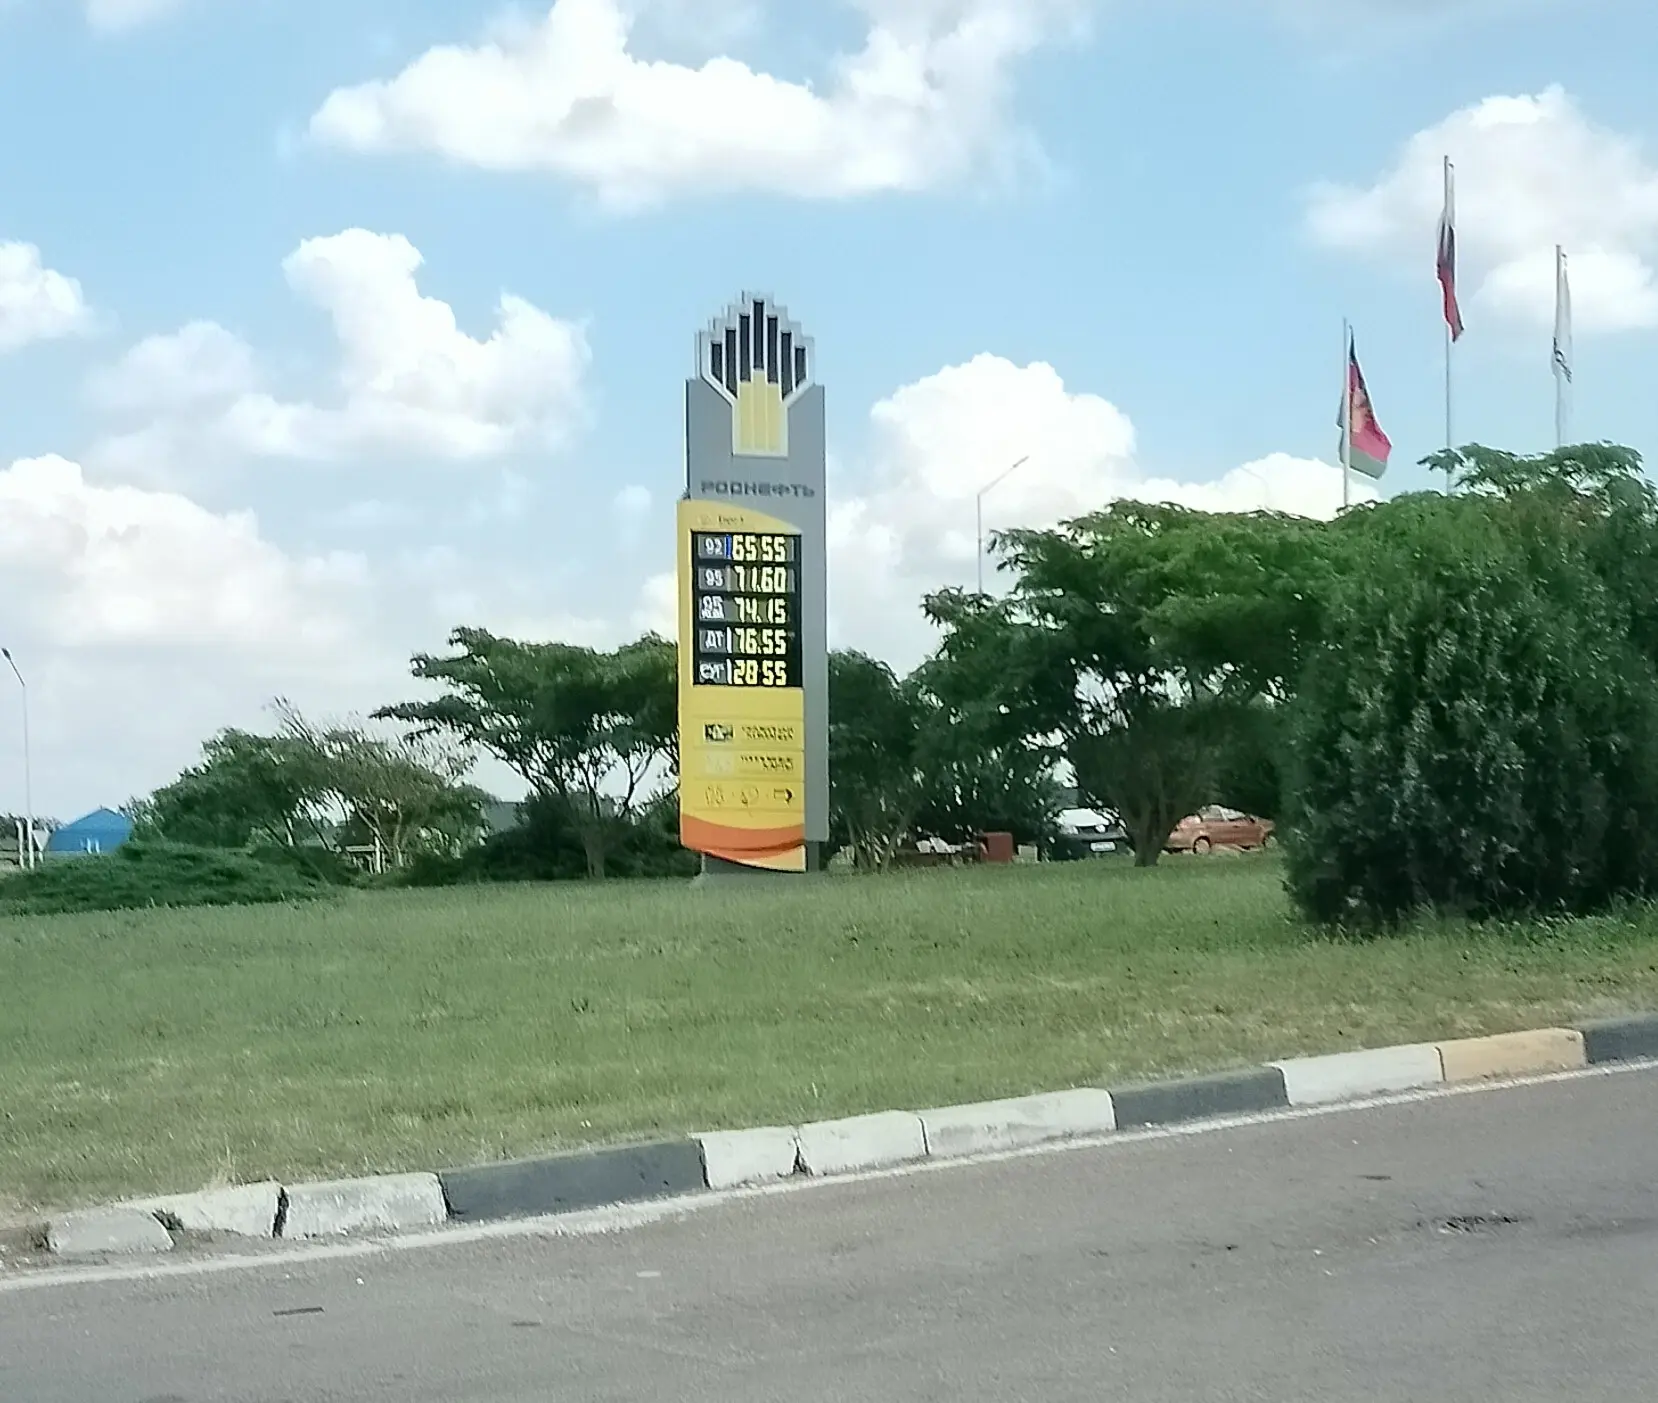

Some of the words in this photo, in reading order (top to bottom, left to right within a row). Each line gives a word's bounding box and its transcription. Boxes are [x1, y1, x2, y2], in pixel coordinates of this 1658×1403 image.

[732, 534, 786, 562] 6555
[734, 565, 787, 593] 71.60
[734, 597, 786, 624] 74.15
[734, 628, 787, 655] 76.55
[733, 659, 787, 686] 2855
